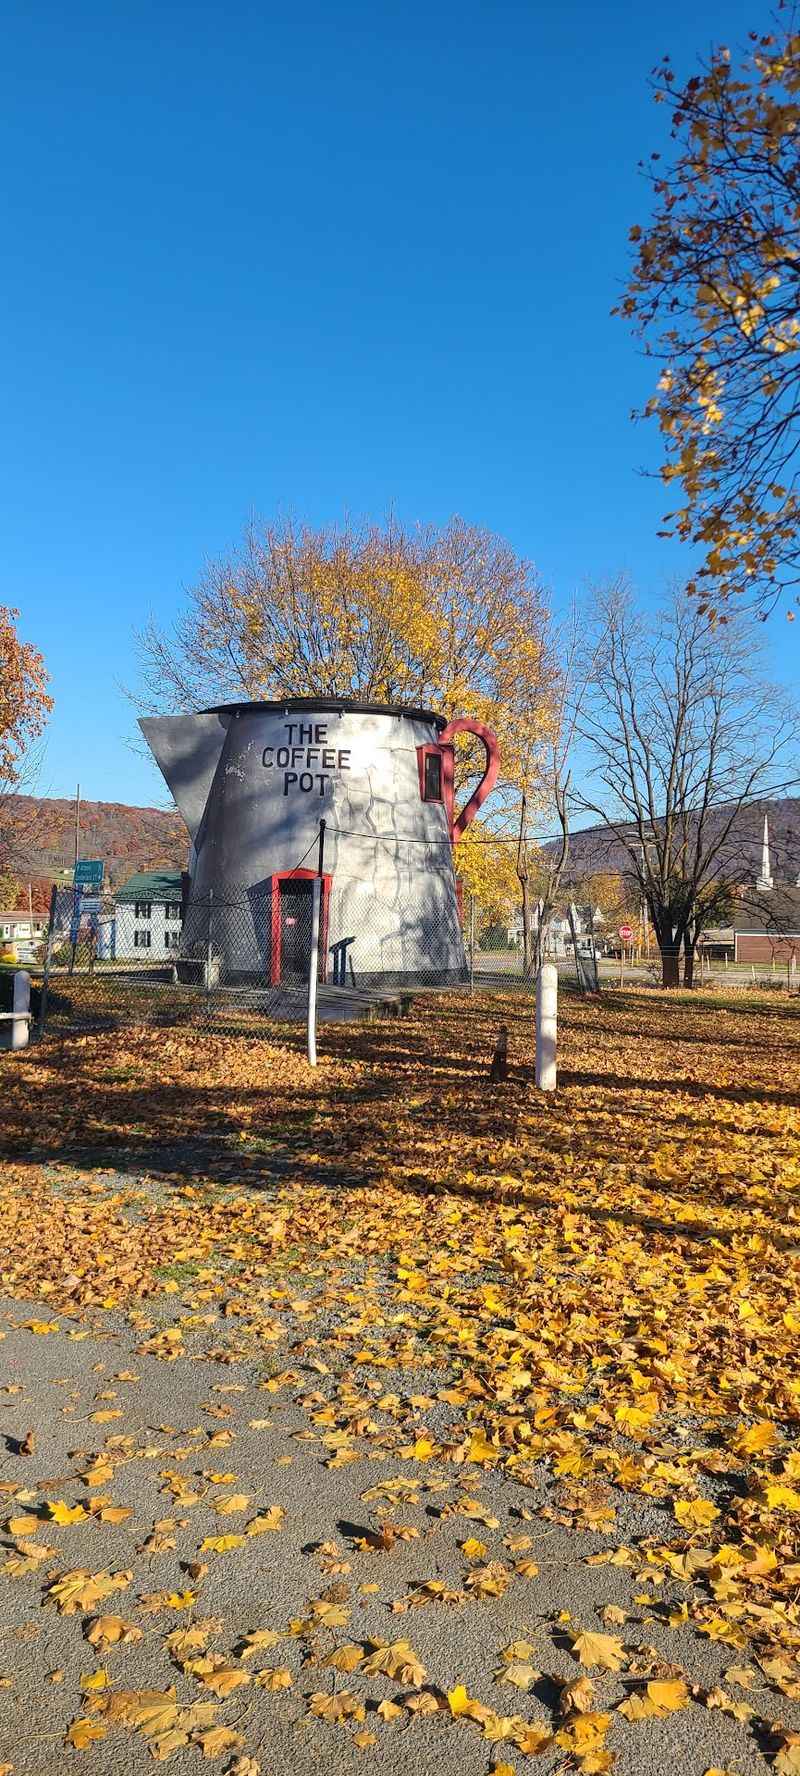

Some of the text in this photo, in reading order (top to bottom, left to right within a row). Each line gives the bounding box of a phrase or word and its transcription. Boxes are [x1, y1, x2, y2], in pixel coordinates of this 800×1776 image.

[284, 723, 328, 745] THE
[262, 746, 351, 769] COFFEE
[283, 772, 329, 796] POT
